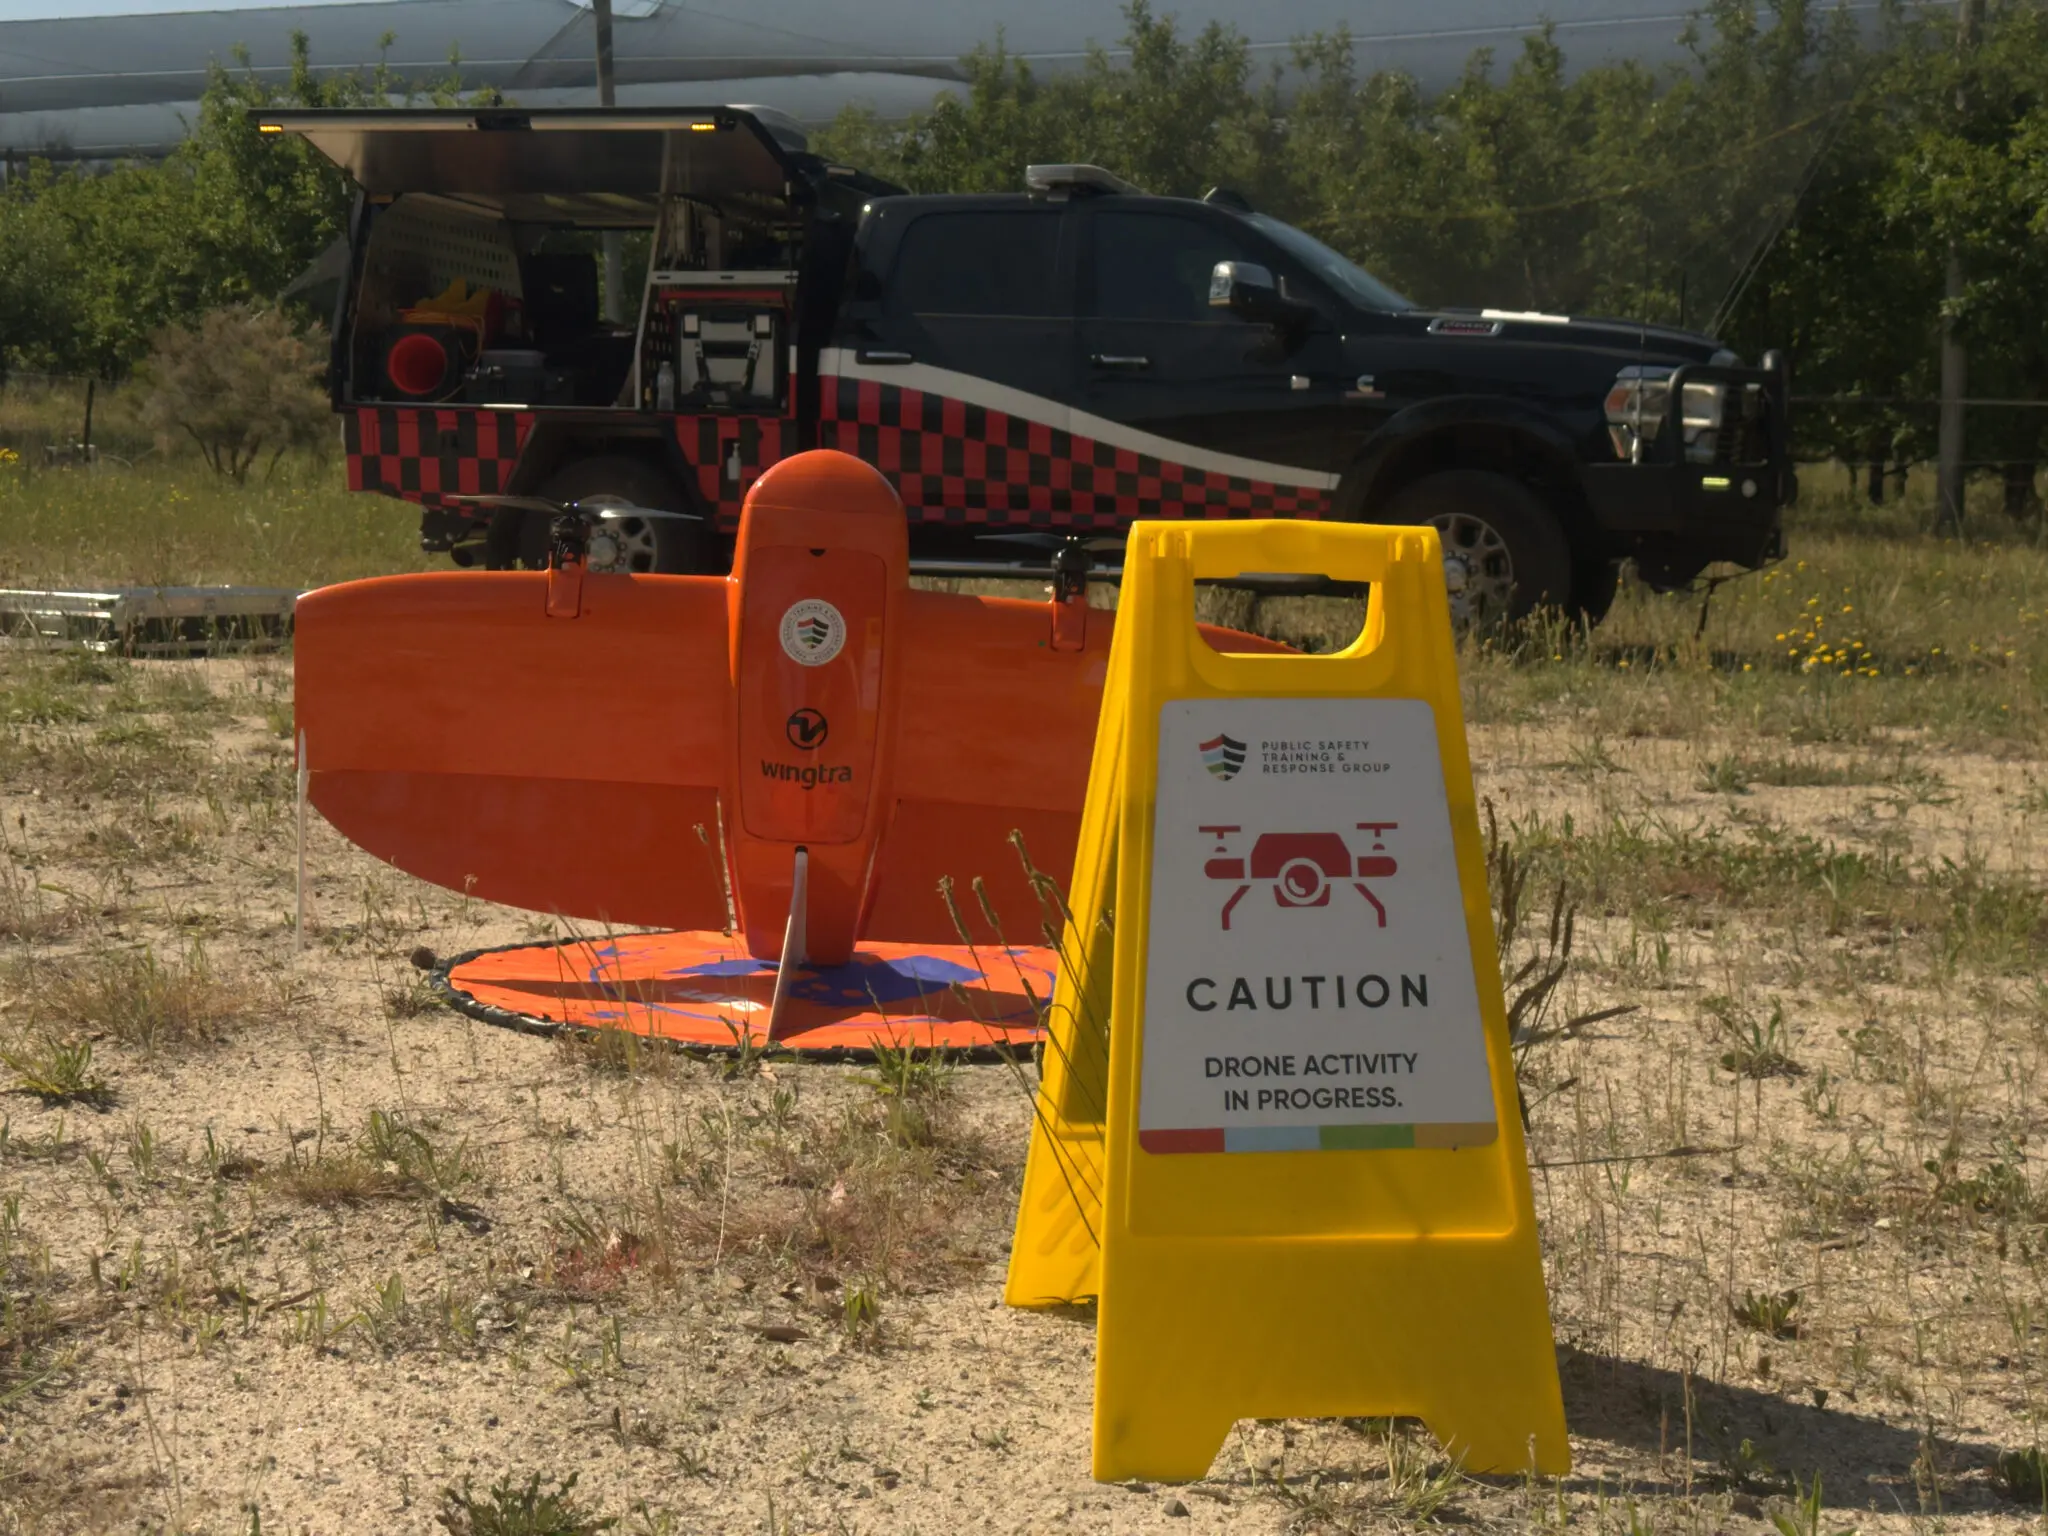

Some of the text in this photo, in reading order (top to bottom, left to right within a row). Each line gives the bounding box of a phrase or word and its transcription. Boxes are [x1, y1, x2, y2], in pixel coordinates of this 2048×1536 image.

[1262, 741, 1370, 751] PUBLIC SAFETY
[1262, 752, 1345, 762] TRAINING &
[761, 759, 853, 791] wingtra
[1262, 762, 1391, 774] RESPONSE GROUP
[1186, 973, 1429, 1012] CAUTION
[1204, 1053, 1418, 1078] DRONE ACTIVITY
[1224, 1086, 1403, 1111] IN PROGRESS.
